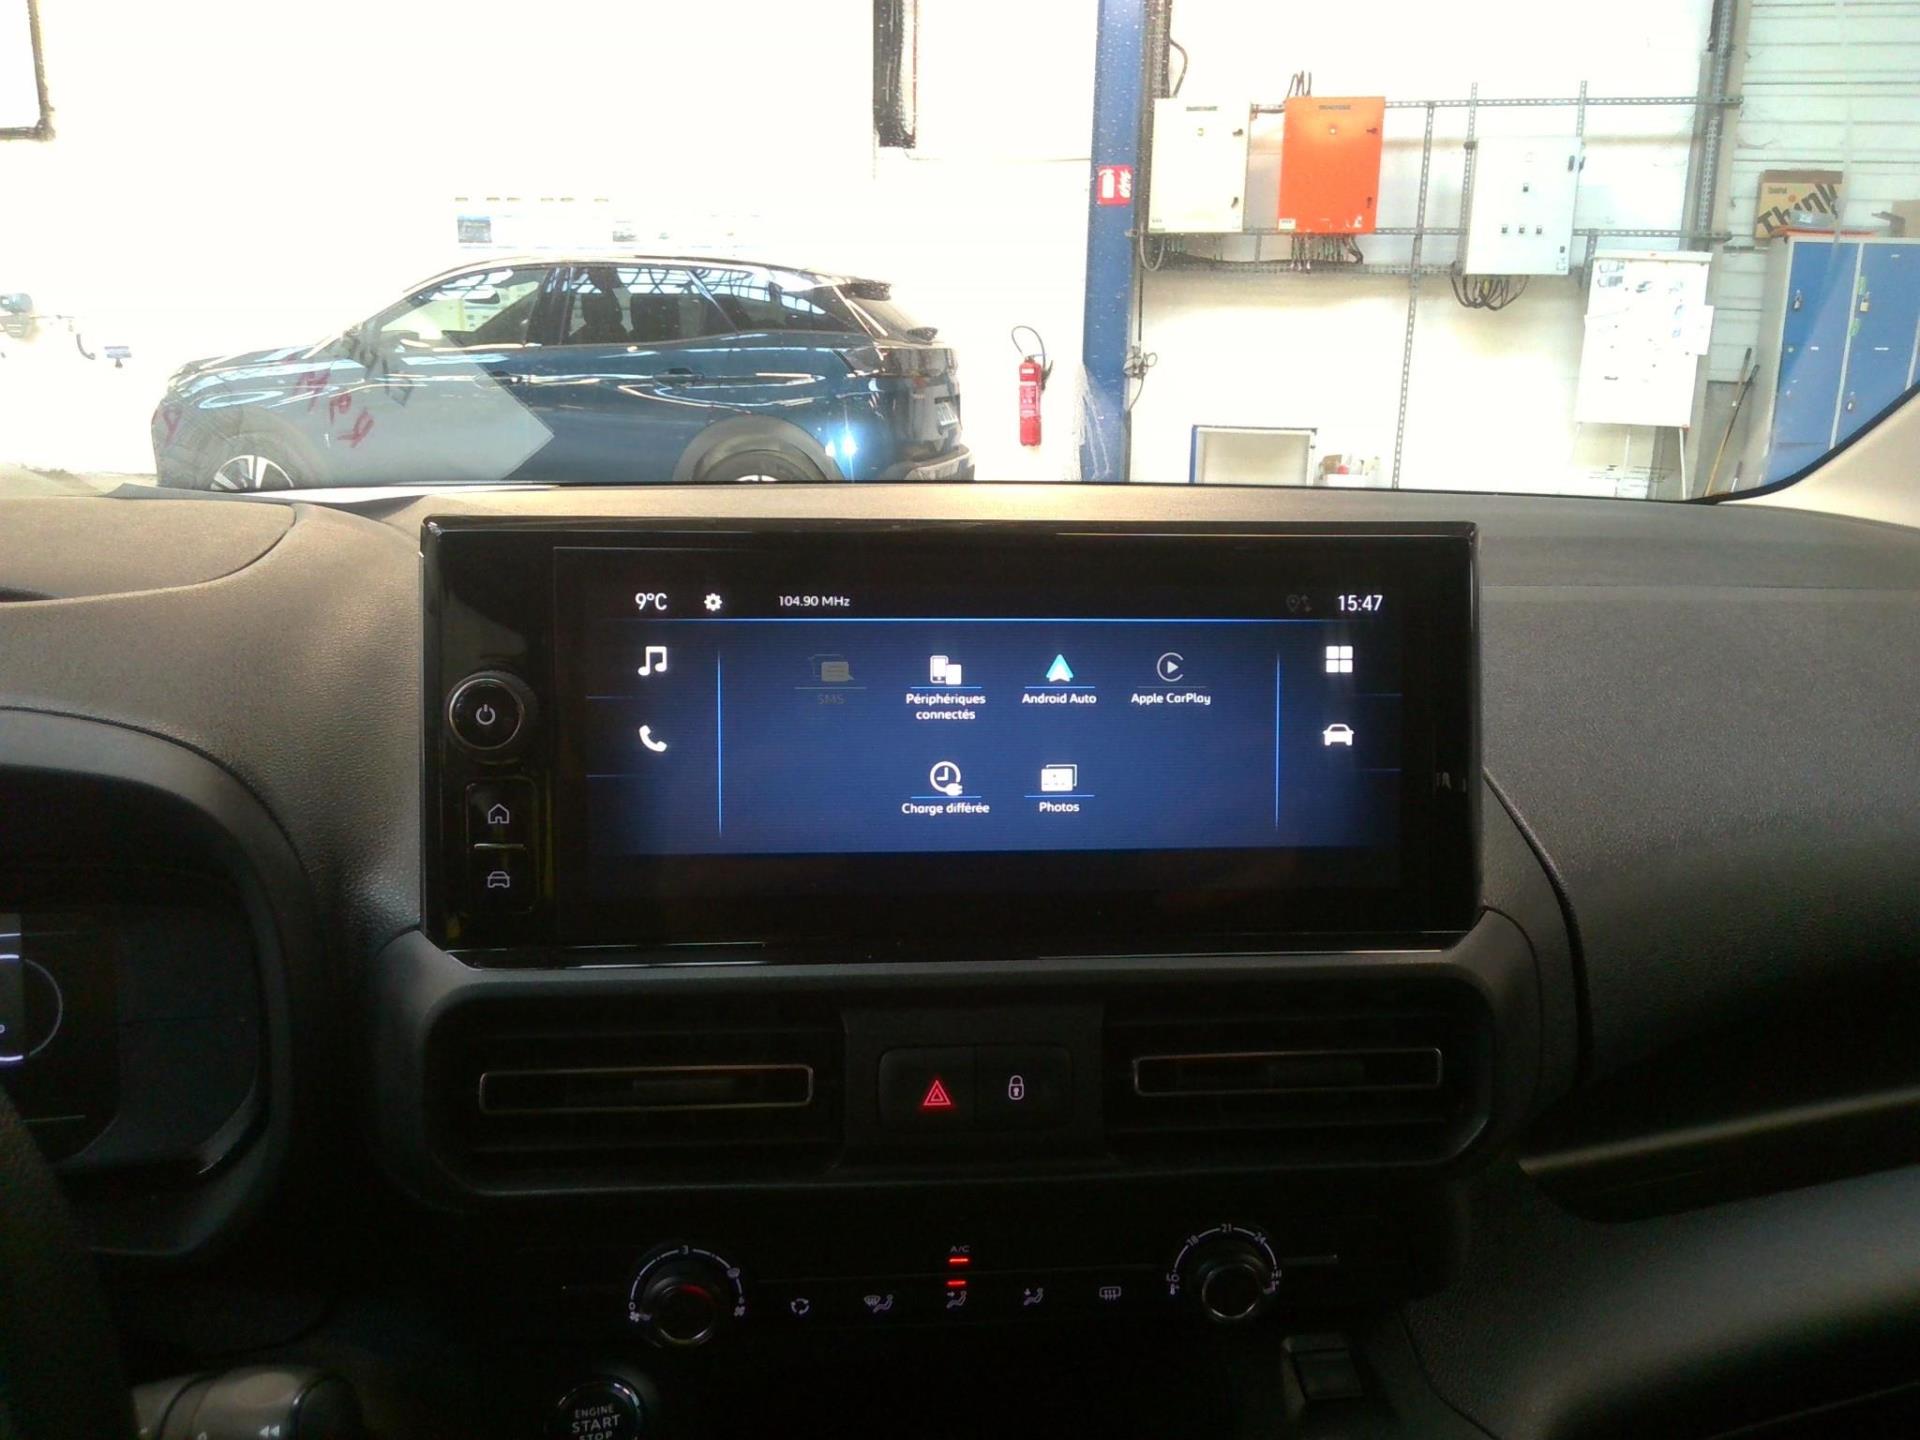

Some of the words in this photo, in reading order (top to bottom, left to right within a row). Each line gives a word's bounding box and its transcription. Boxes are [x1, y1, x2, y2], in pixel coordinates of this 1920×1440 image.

[634, 592, 668, 611] 9°C
[778, 595, 819, 607] 104.90
[821, 596, 851, 607] MHz
[1337, 594, 1384, 612] 15:47
[905, 692, 986, 706] Périphériques
[1021, 692, 1067, 704] Android
[1068, 693, 1097, 704] Auto
[1130, 692, 1163, 706] Apple
[1165, 692, 1211, 706] CarPlay
[915, 708, 976, 720] connectés
[901, 802, 944, 815] Charge
[945, 801, 990, 814] différée
[1038, 801, 1080, 813] Photos
[575, 1404, 615, 1419] ENGINE
[571, 1414, 621, 1434] START
[578, 1430, 613, 1440] STOP
